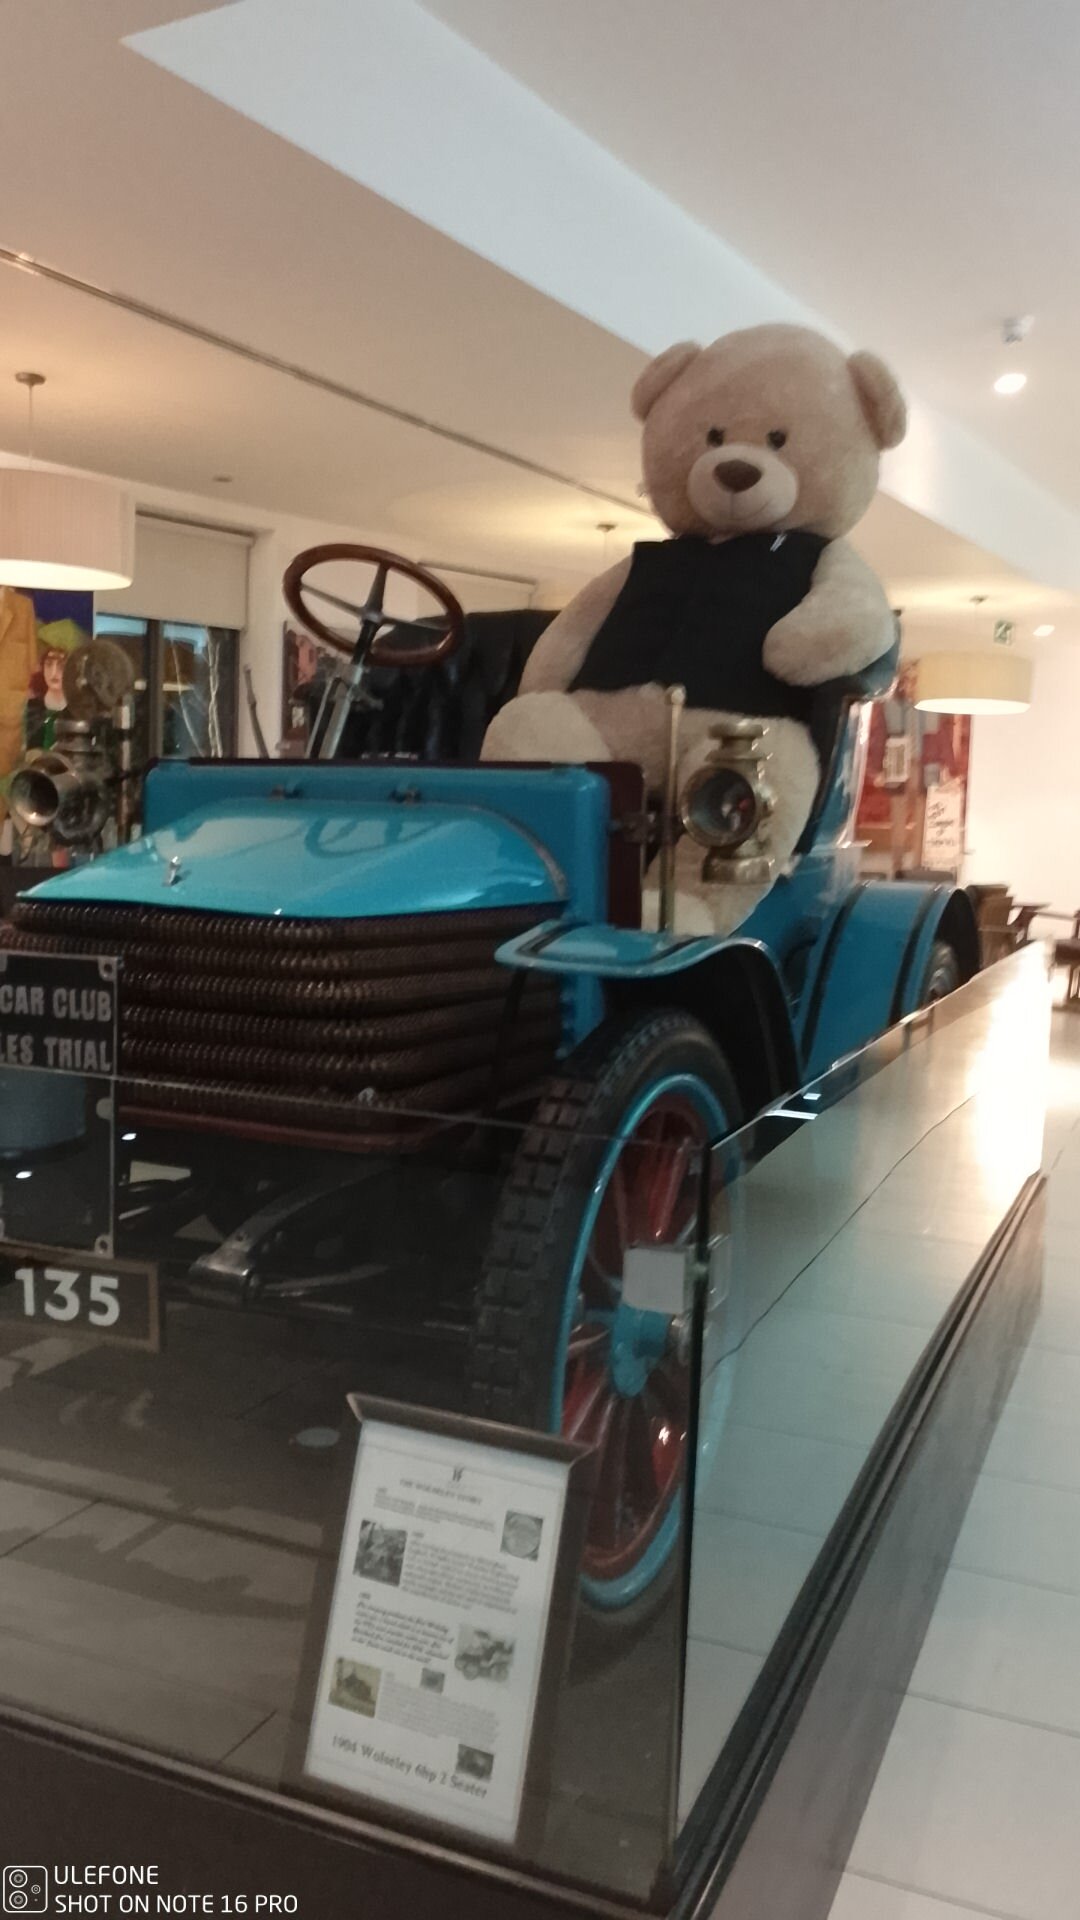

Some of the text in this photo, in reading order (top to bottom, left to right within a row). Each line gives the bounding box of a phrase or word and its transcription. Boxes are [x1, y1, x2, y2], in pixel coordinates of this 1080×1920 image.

[0, 985, 112, 1022] CAR CLUB
[43, 1036, 112, 1072] TRIAL
[14, 1267, 120, 1326] 135
[361, 1745, 412, 1775] Wolseley
[440, 1773, 447, 1786] 2
[451, 1775, 488, 1800] Seater
